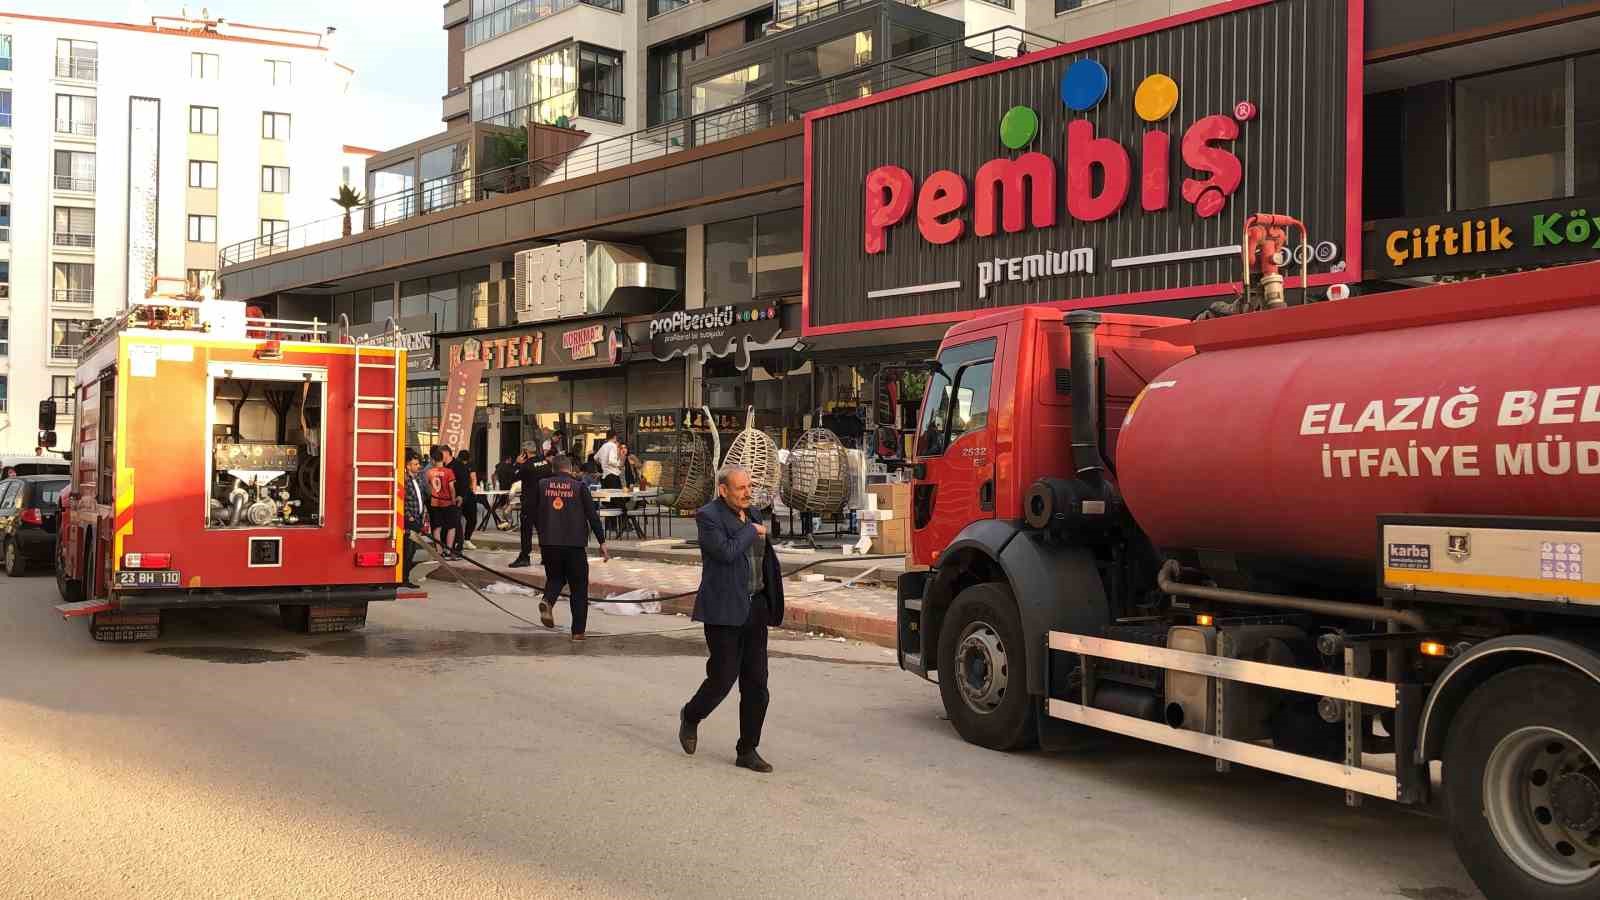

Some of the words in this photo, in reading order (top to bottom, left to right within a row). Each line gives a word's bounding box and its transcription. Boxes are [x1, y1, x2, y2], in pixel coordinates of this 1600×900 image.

[1386, 217, 1514, 266] Çiftlik
[1300, 385, 1480, 435] ELAZIĞ
[962, 447, 987, 457] 2532
[1319, 439, 1481, 478] İTFAİYE
[1391, 544, 1429, 558] karba
[121, 573, 135, 583] 23
[139, 573, 154, 583] BH
[162, 573, 178, 583] 110
